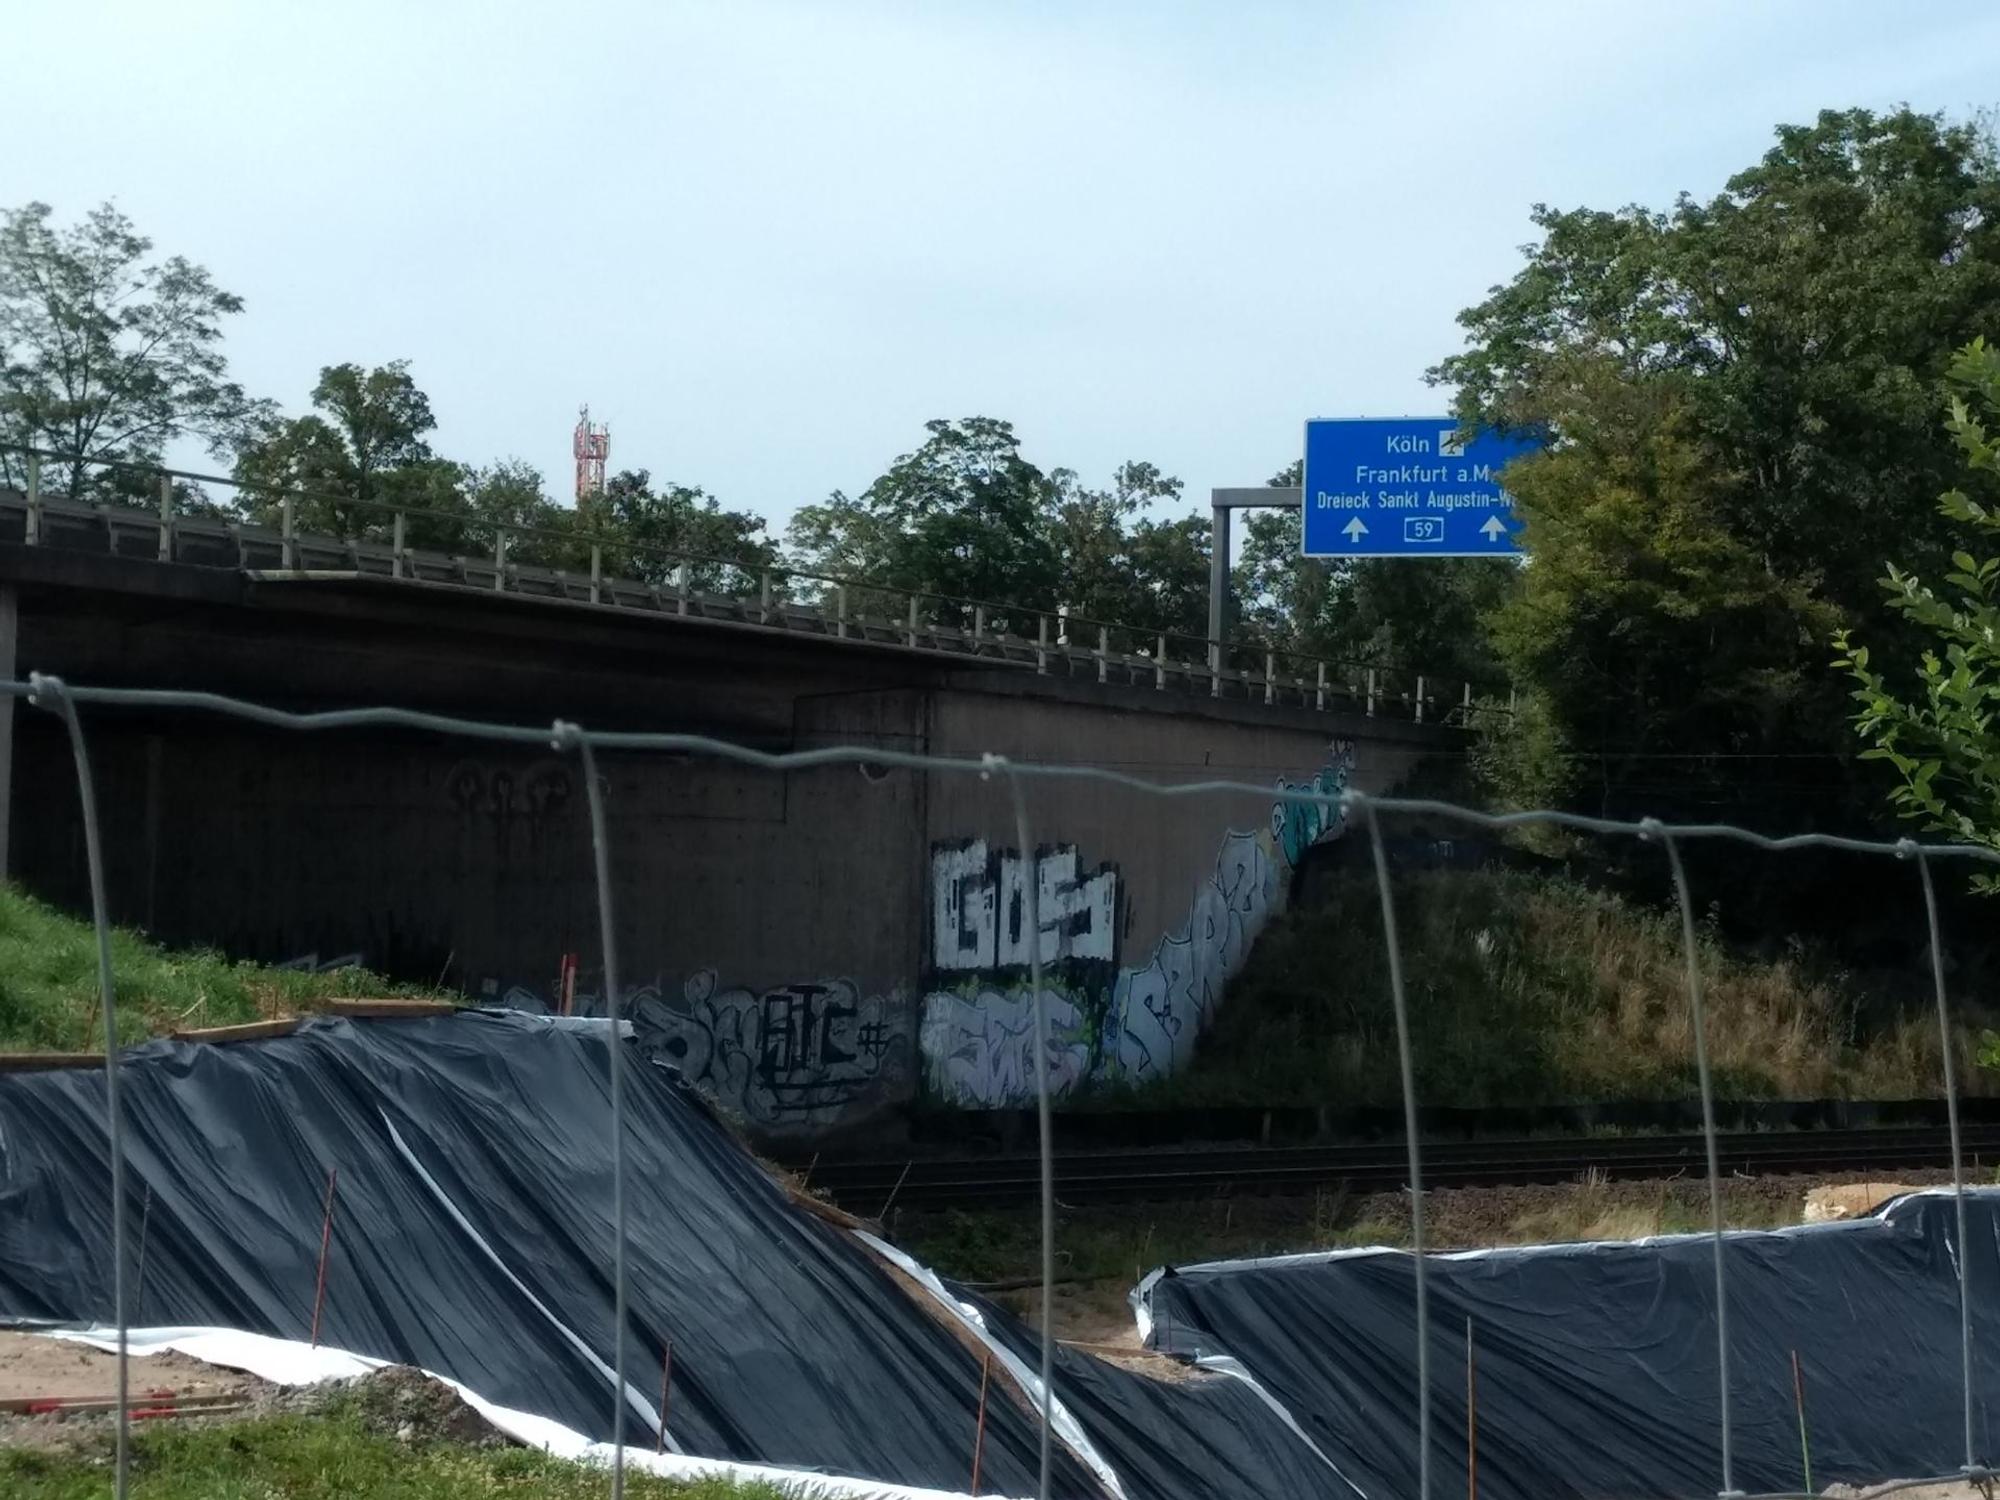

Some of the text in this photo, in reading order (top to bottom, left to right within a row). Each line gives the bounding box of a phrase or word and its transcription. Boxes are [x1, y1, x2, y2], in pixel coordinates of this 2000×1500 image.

[1387, 435, 1430, 453] Köln
[1356, 465, 1448, 484] Frankfurt
[1317, 491, 1370, 509] Dreieck
[1378, 490, 1419, 508] Sankt
[1414, 522, 1434, 537] 59
